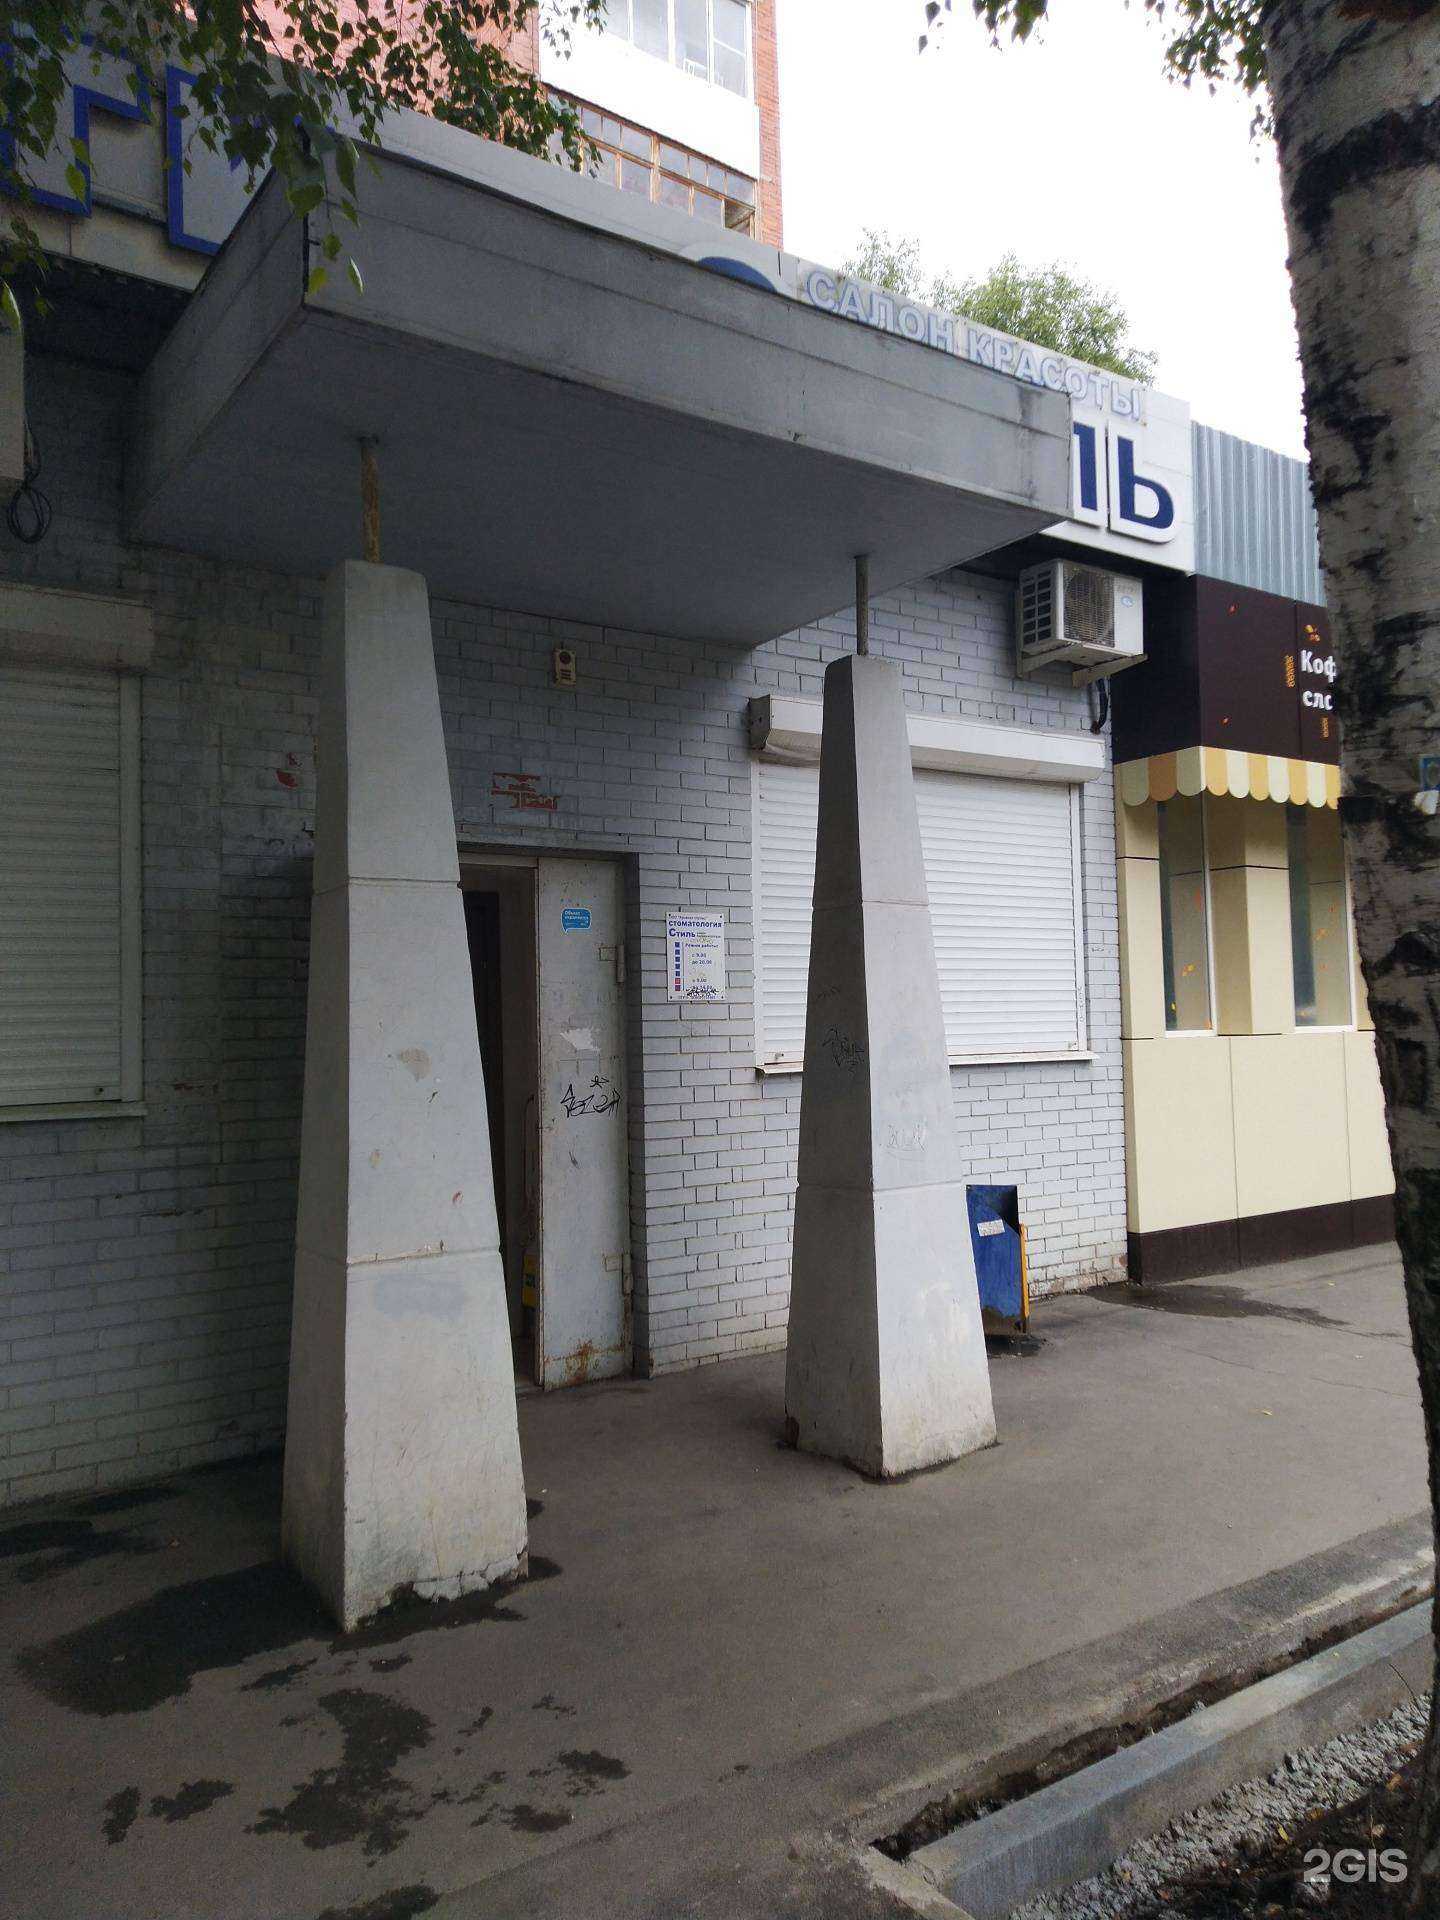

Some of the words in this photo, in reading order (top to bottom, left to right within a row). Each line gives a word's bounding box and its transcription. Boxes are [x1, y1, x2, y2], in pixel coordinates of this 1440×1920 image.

[806, 269, 957, 354] САЛОН
[966, 326, 1144, 423] КРАСОТЫ
[668, 928, 696, 939] Стиль
